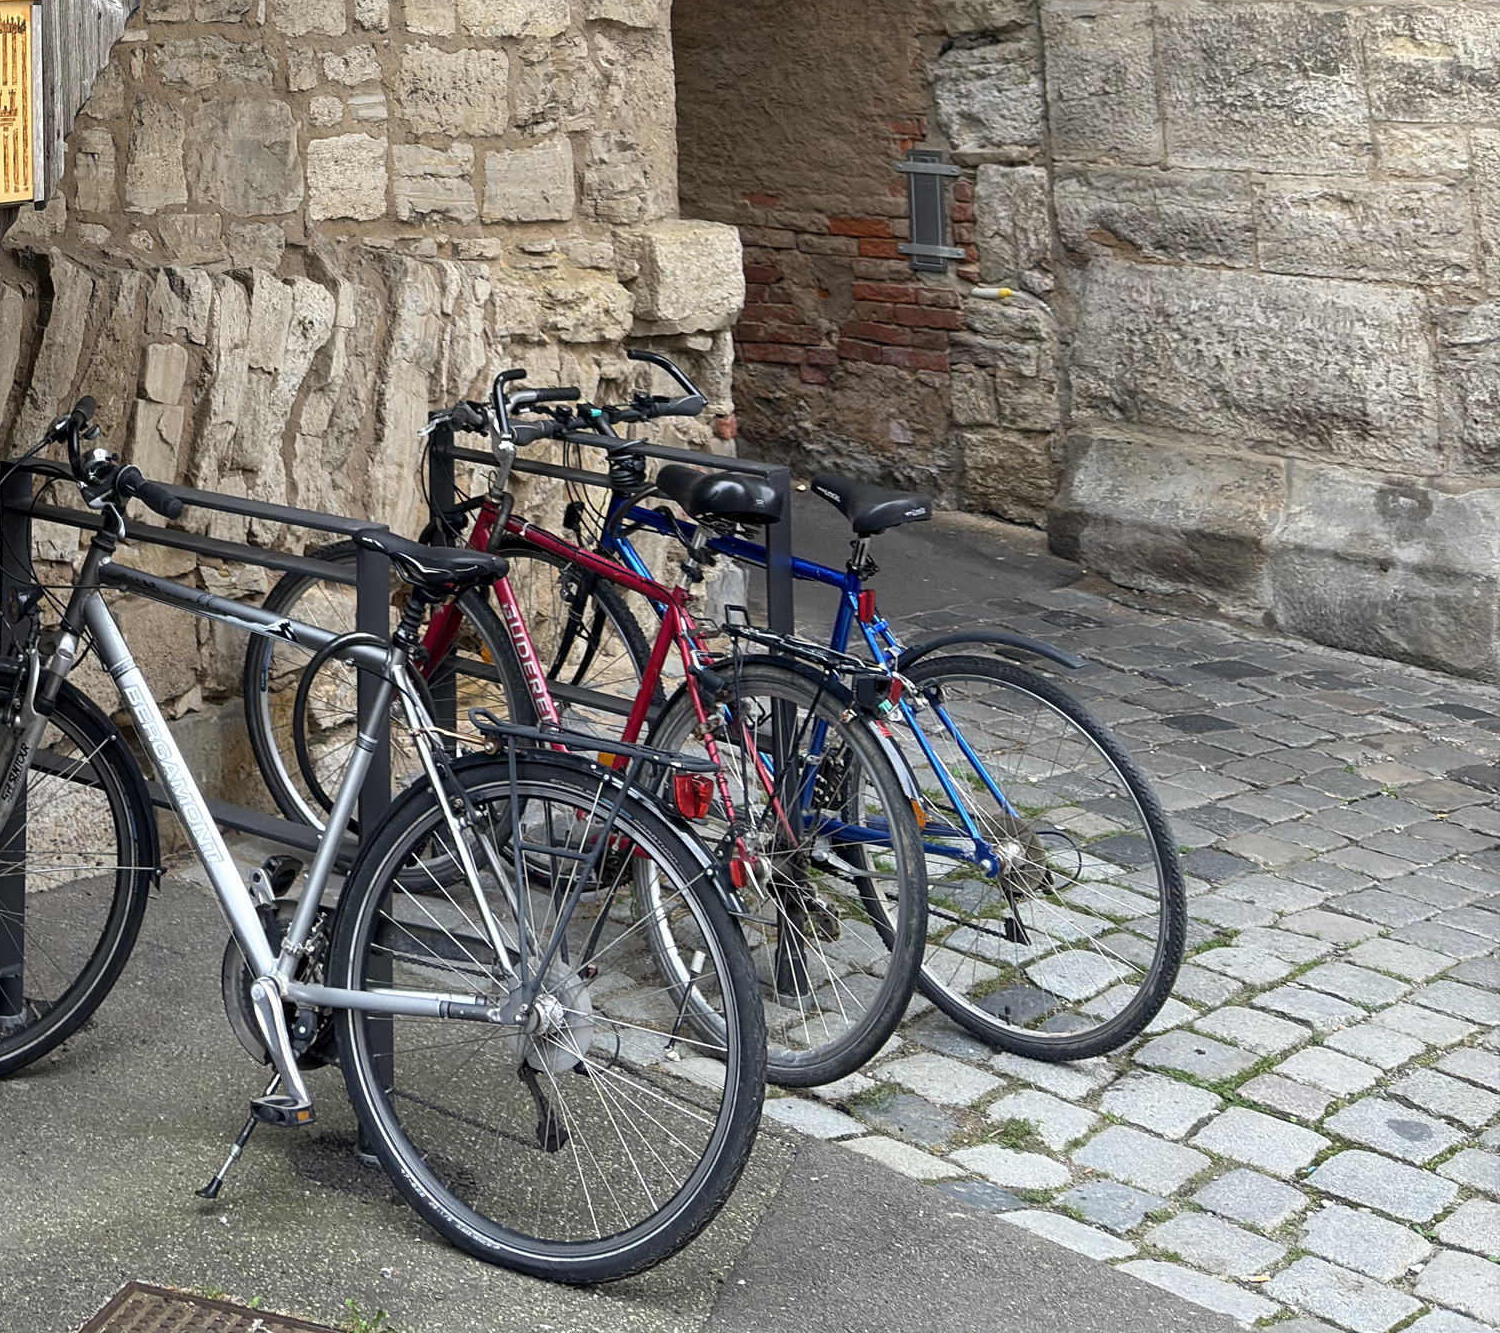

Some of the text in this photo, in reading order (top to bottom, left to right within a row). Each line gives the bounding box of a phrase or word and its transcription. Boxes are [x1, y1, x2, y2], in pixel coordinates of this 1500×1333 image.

[502, 603, 556, 726] GUDEREI
[8, 742, 30, 783] SUNTOUR
[123, 684, 225, 864] BERGAMONT
